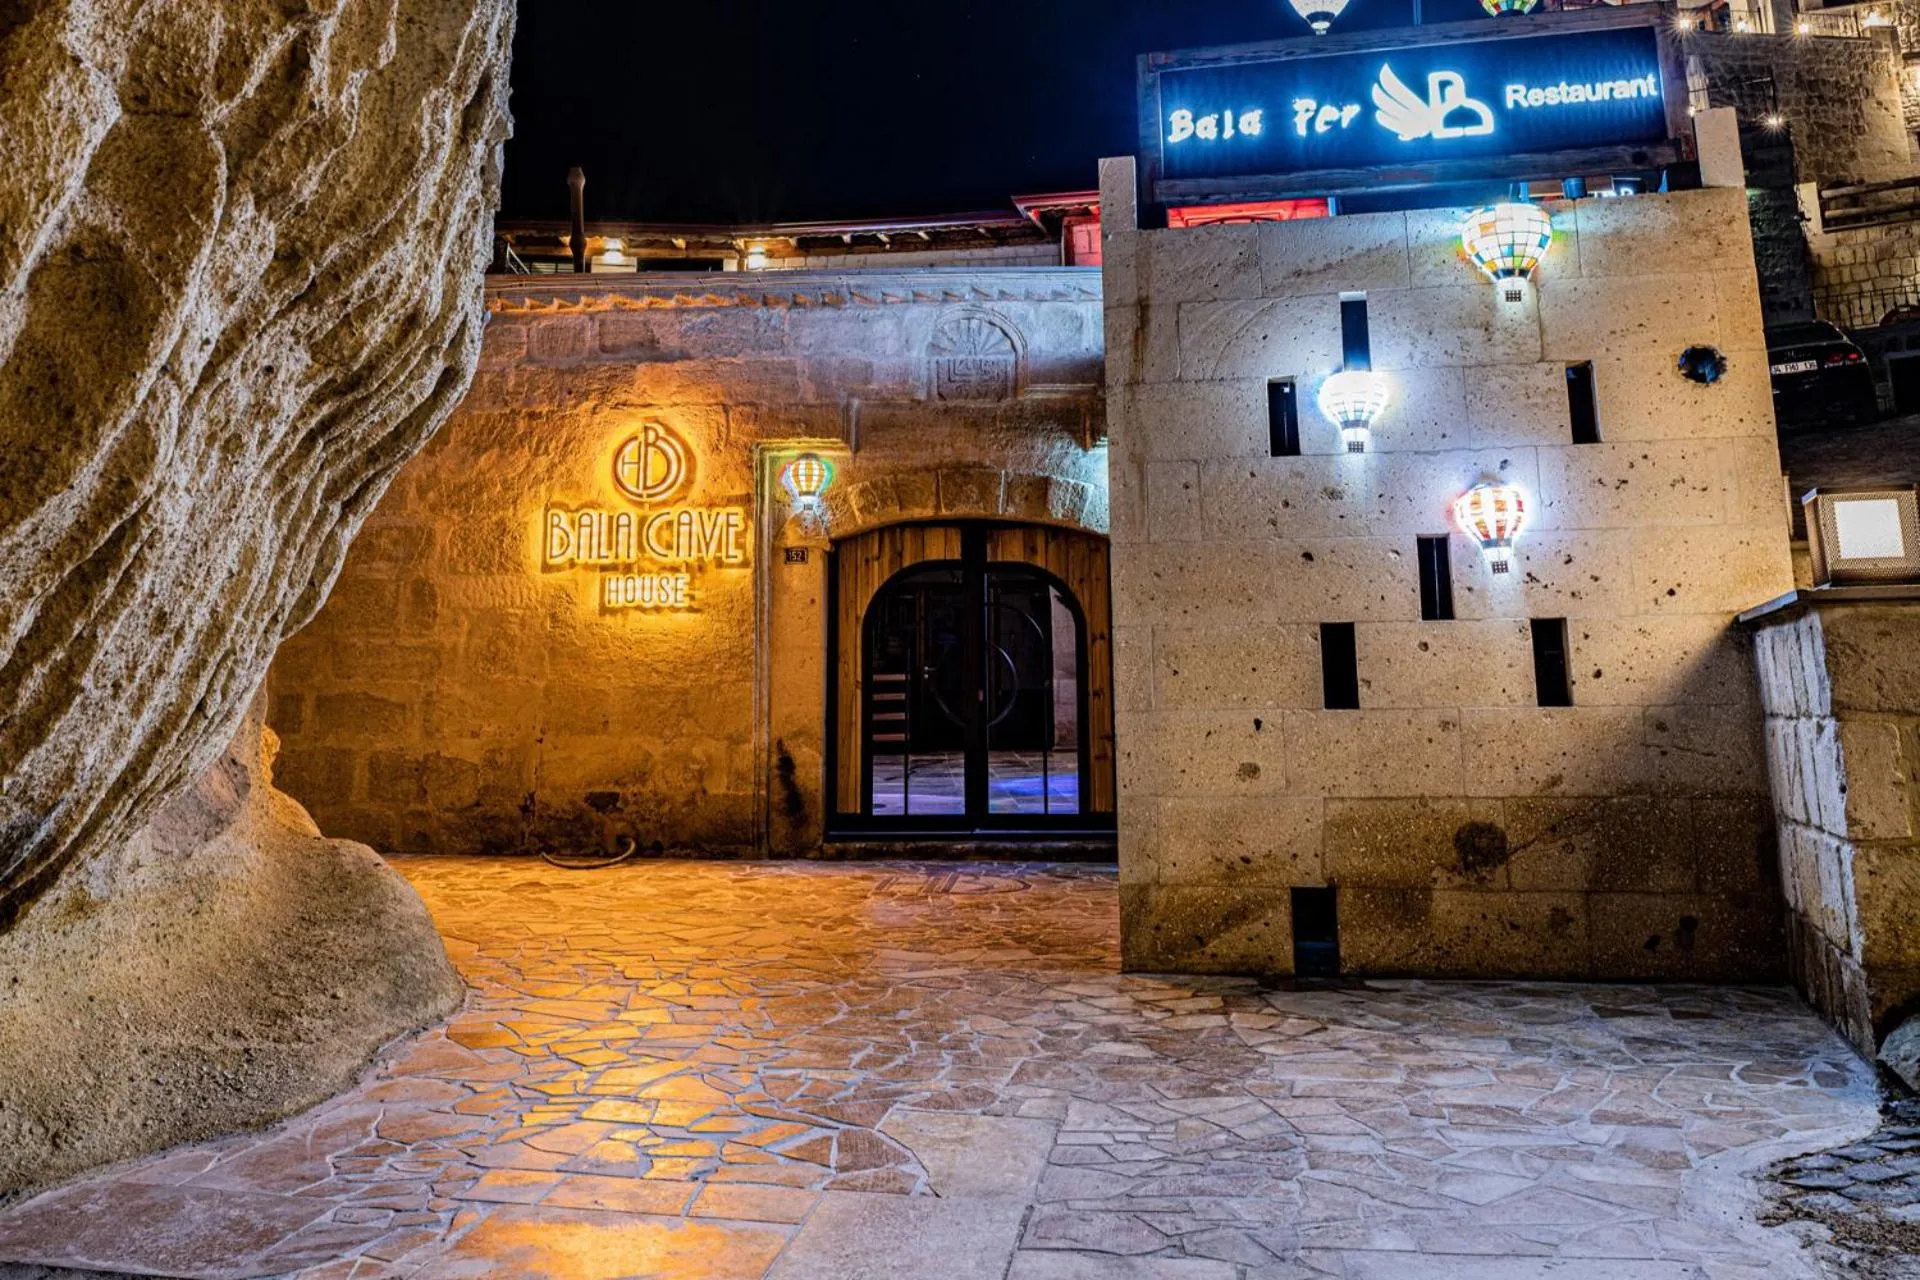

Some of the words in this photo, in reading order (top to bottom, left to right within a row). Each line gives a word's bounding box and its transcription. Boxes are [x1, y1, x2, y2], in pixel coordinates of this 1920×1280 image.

[1168, 109, 1262, 143] Bala
[1505, 74, 1658, 109] Restaurant
[548, 509, 633, 561] BALA
[644, 509, 742, 561] CAVE
[605, 575, 686, 606] HOUSE
